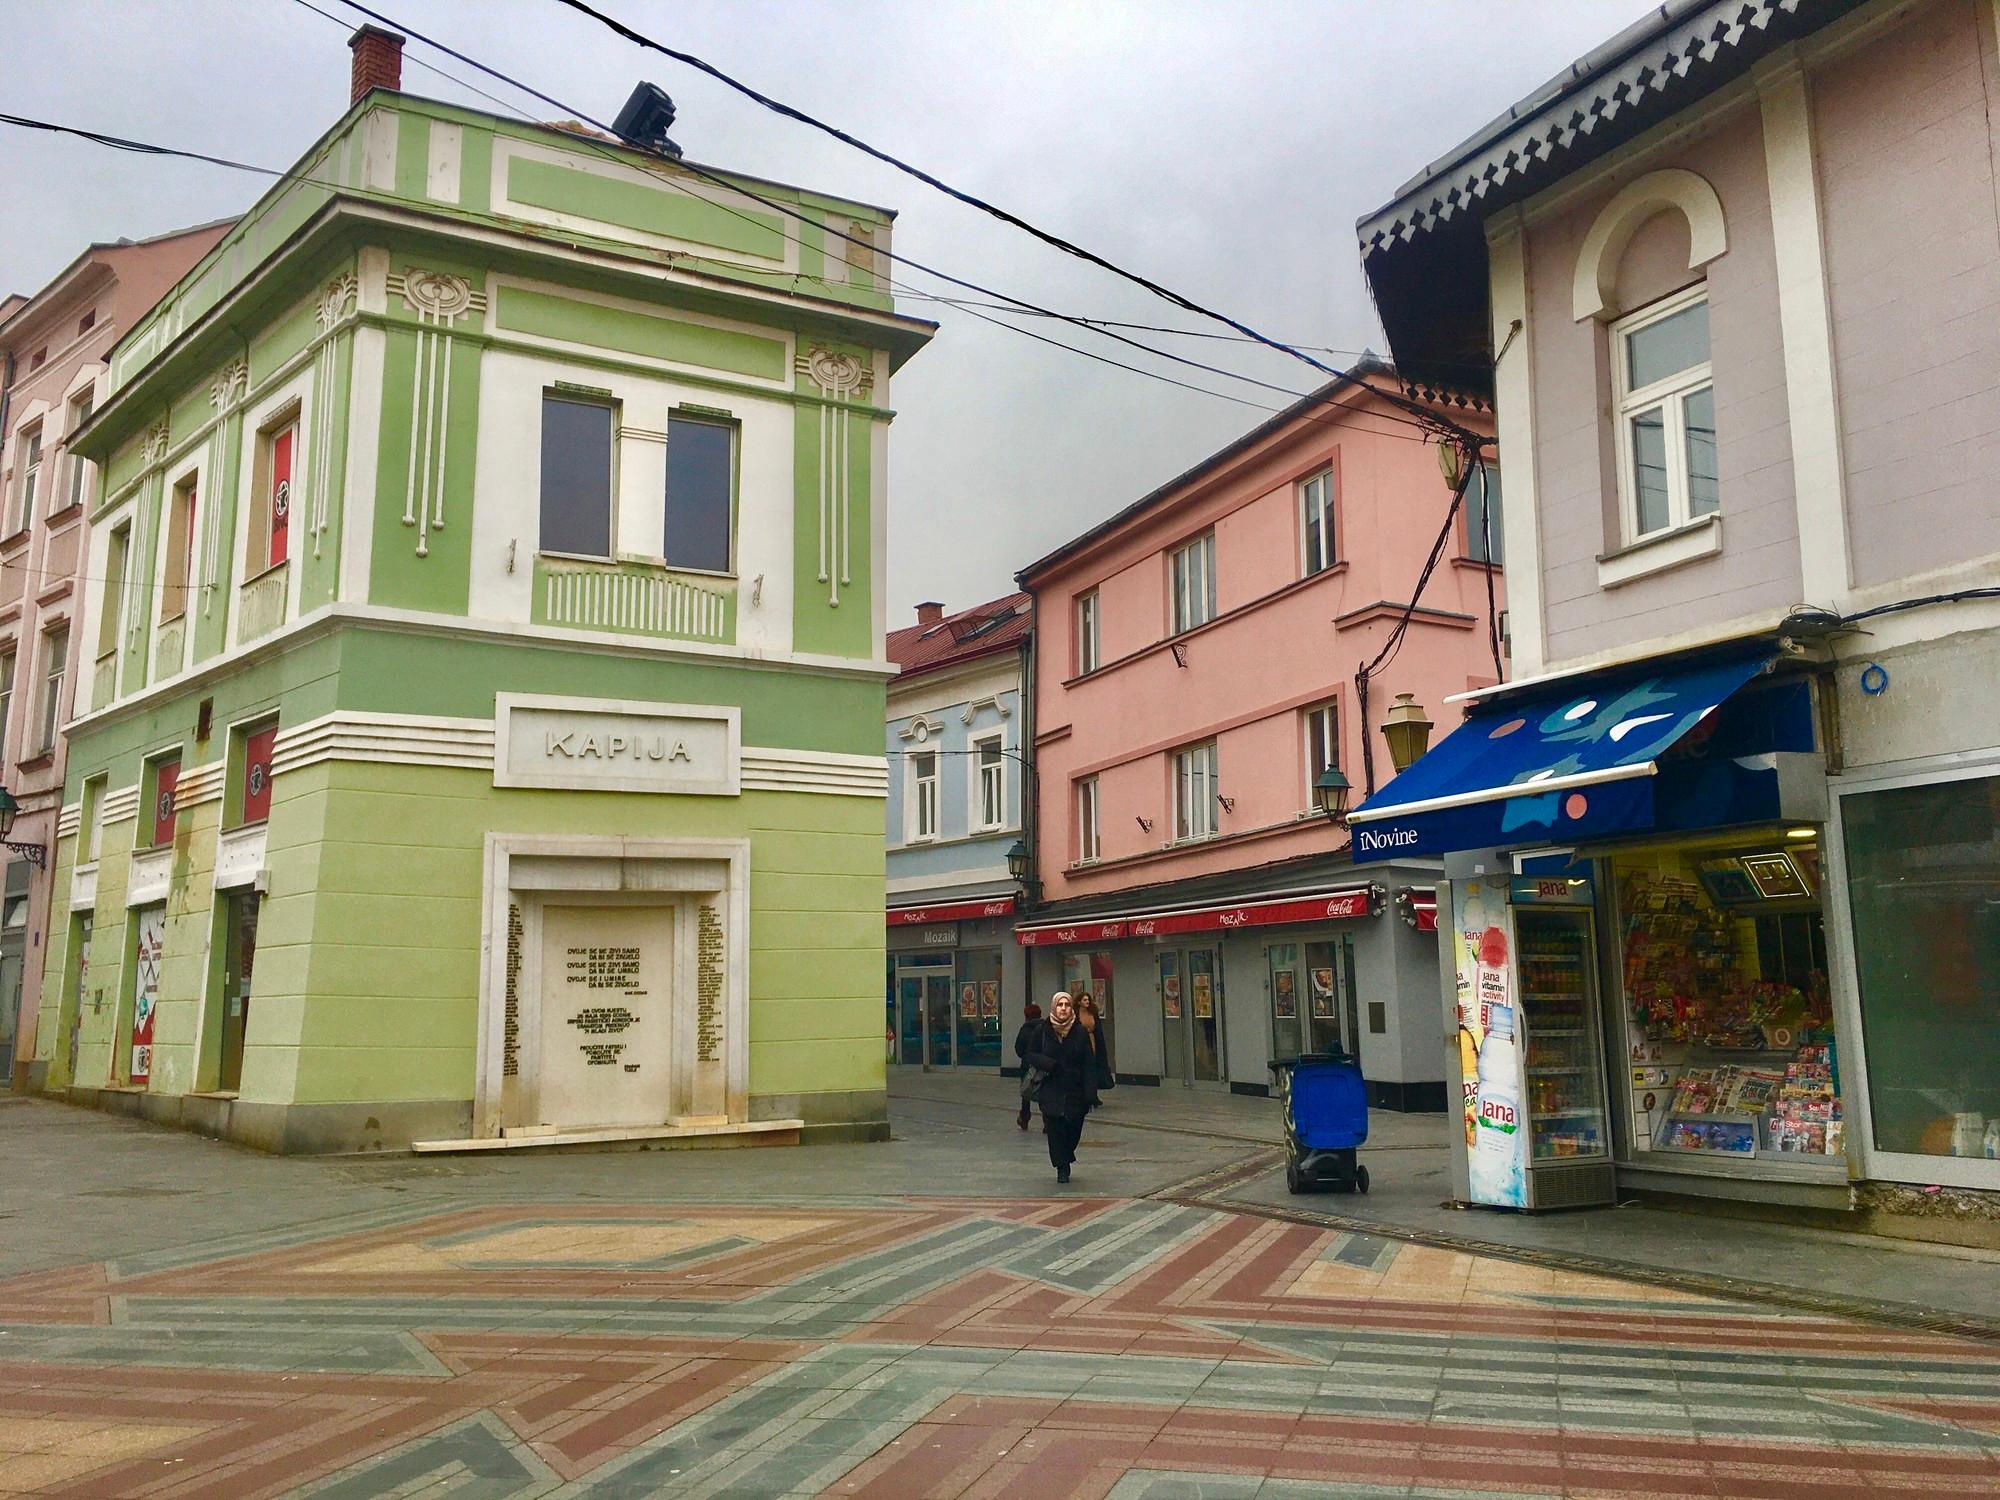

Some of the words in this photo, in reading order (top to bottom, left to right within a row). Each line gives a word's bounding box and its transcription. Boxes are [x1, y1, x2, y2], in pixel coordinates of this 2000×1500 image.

[545, 730, 692, 763] KAPIJA
[1360, 827, 1418, 851] iNovine
[1538, 881, 1568, 898] Jana
[924, 929, 956, 944] Mozaik
[1483, 971, 1500, 983] Jana
[1482, 982, 1505, 993] vitamin
[1482, 991, 1505, 1003] activity
[1482, 1100, 1514, 1123] Jana
